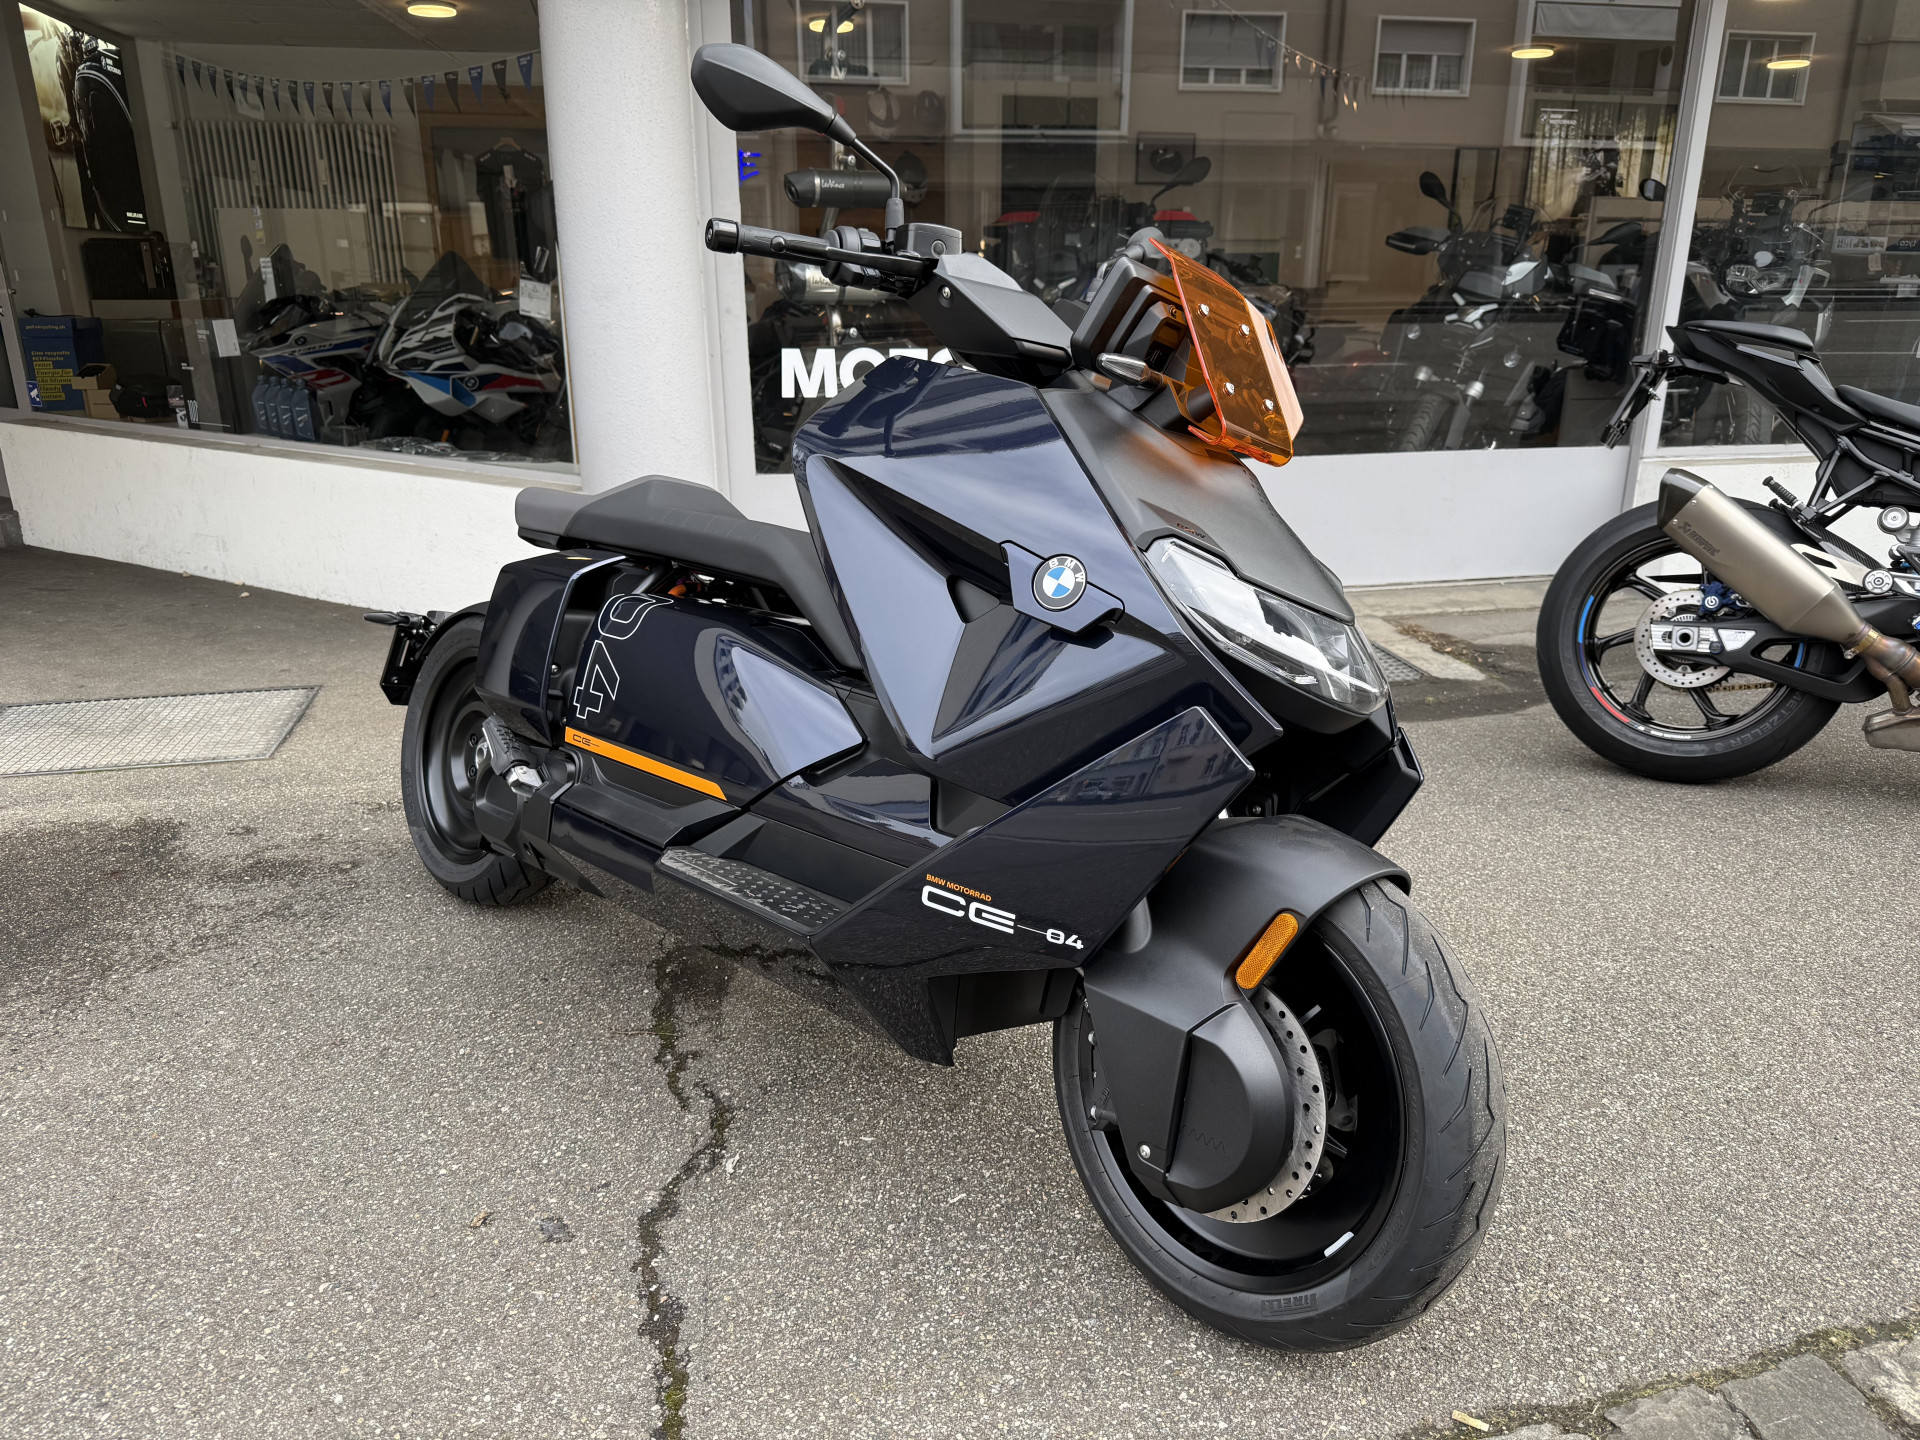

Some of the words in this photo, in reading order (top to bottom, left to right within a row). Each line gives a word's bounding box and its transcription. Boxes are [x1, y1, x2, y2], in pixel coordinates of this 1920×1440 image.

[1048, 557, 1086, 583] BMW
[925, 873, 947, 887] BMW
[946, 881, 993, 903] MOTORRAD
[1261, 1292, 1319, 1318] PIRELLI
